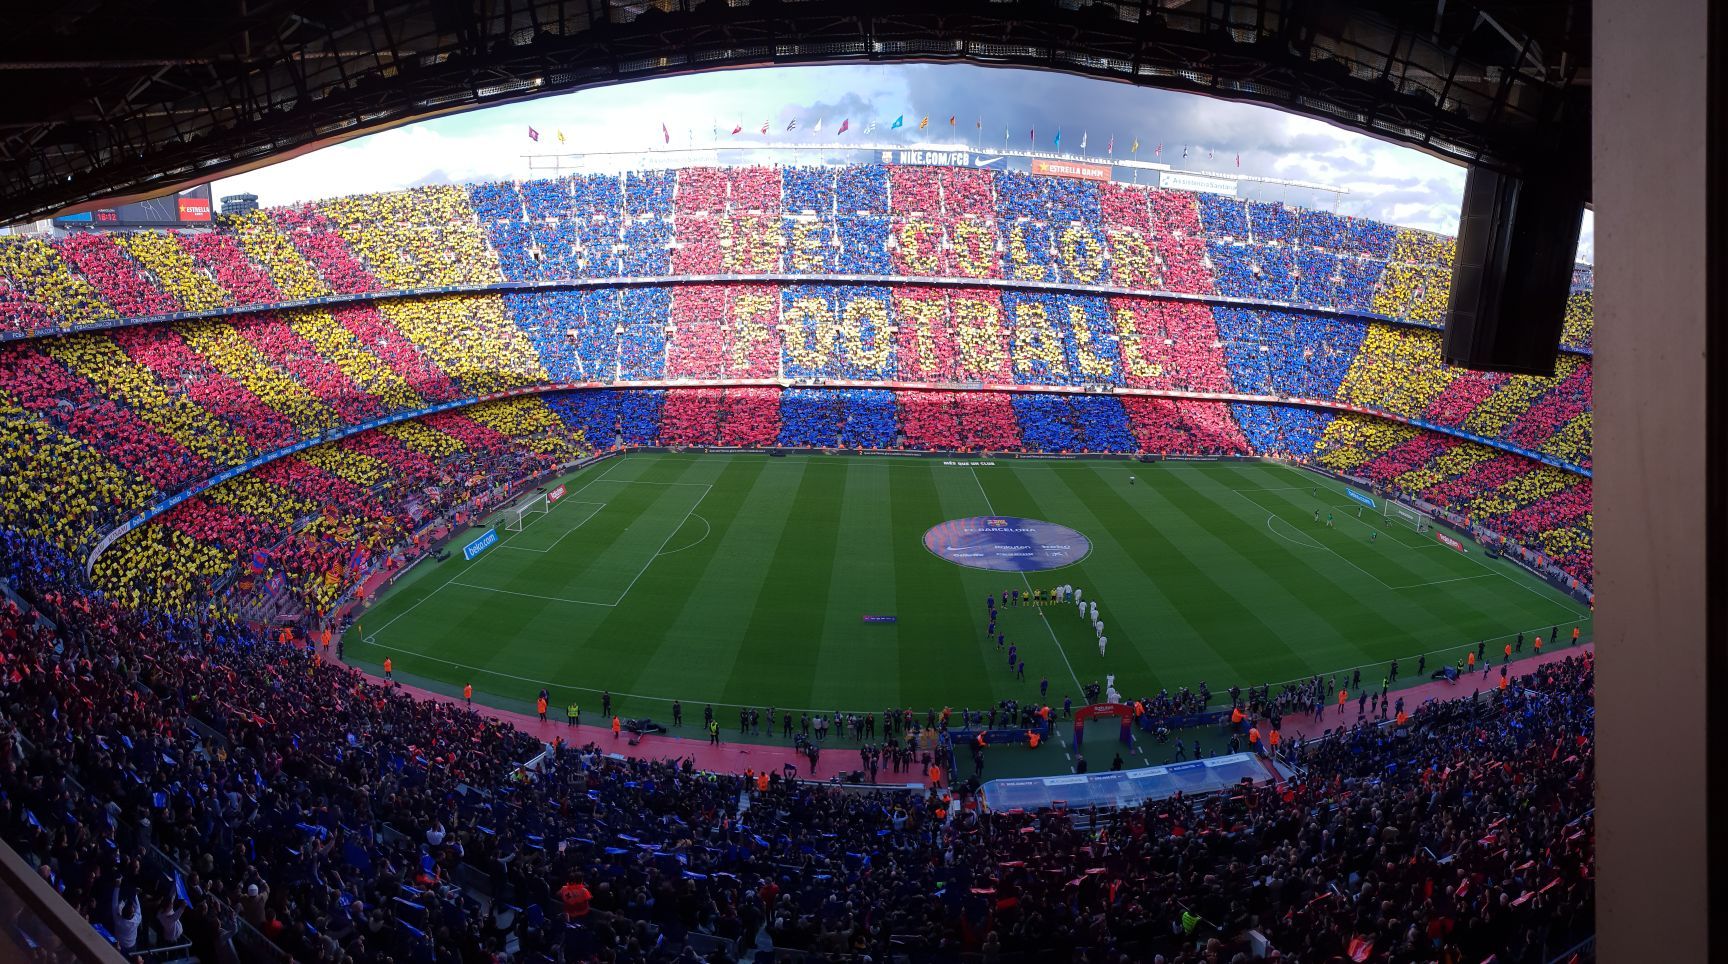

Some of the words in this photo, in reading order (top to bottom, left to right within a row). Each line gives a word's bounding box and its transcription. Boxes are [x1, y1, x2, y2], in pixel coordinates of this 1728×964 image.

[900, 151, 969, 166] NIKE.COM/FCB
[1049, 165, 1080, 175] ESTRELLA
[1082, 169, 1103, 177] DAMM
[719, 215, 825, 272] WE
[900, 218, 1160, 287] COLOR
[732, 294, 1163, 378] FOOTBALL
[468, 534, 496, 556] beko.com
